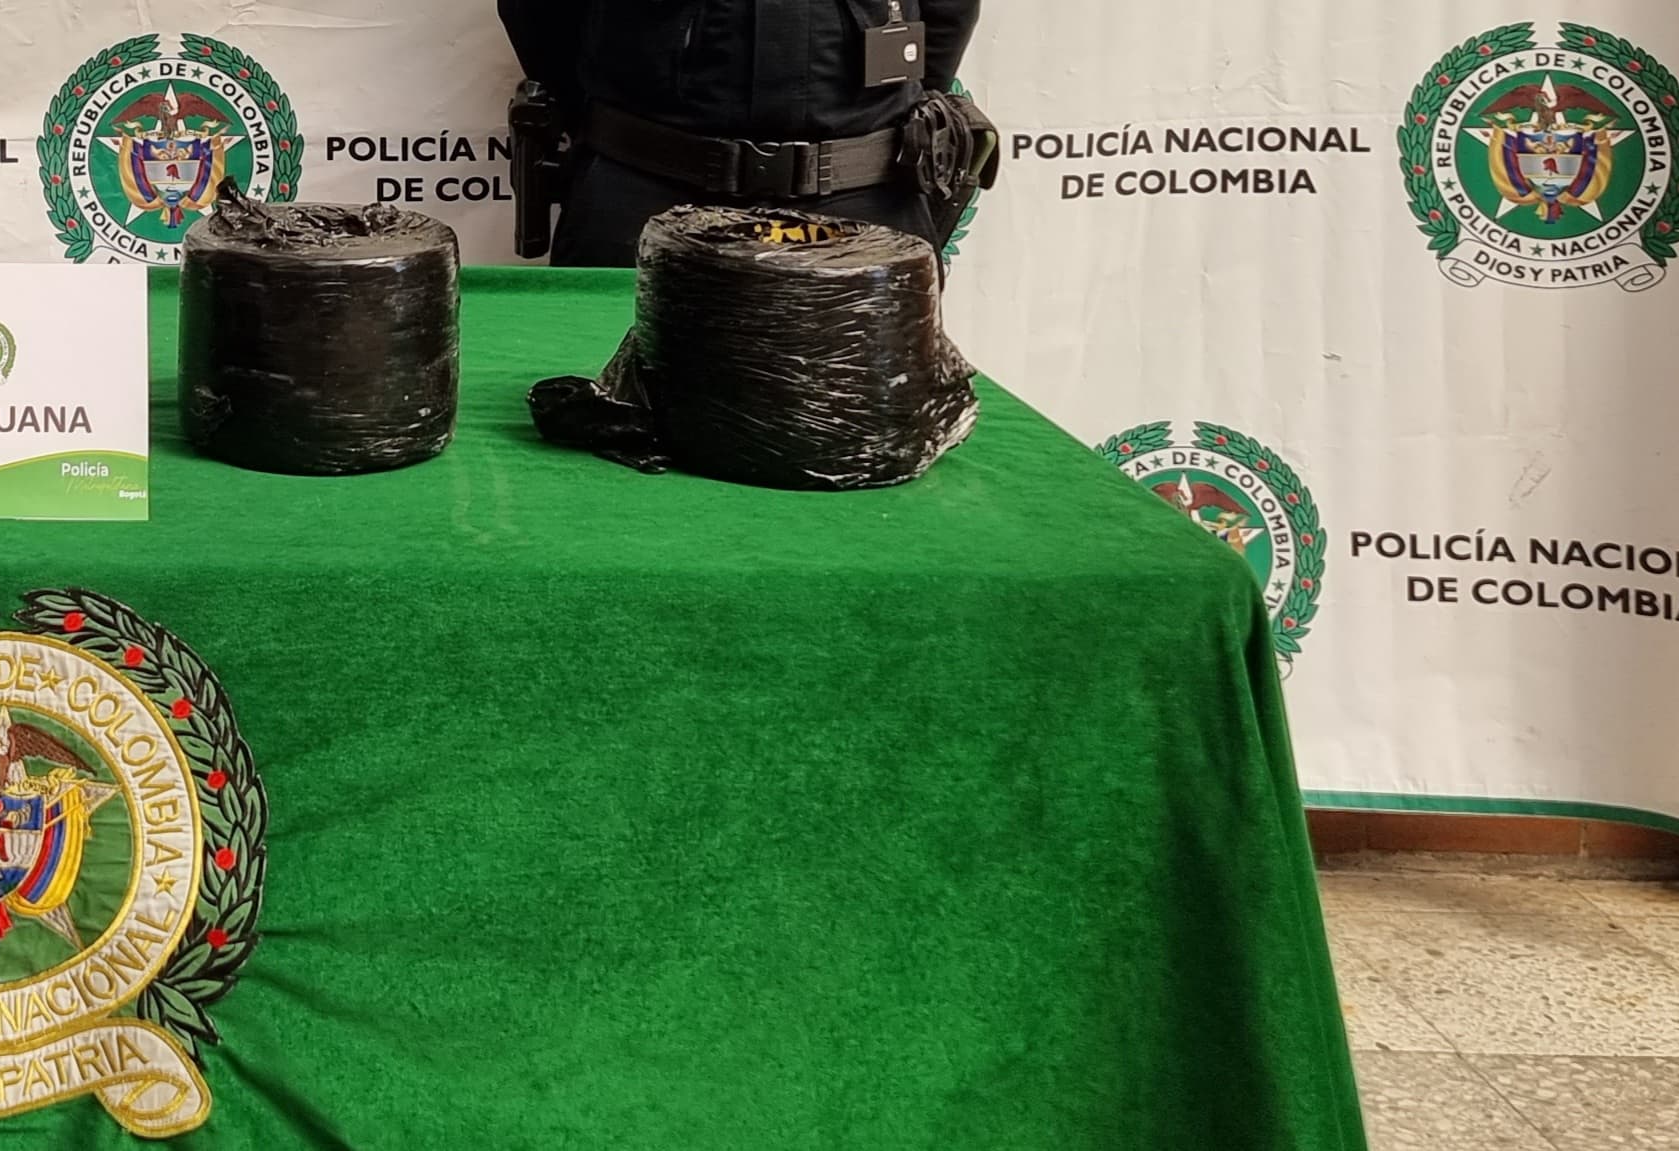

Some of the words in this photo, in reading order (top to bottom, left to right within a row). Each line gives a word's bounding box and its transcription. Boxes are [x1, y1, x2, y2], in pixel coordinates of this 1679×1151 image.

[1536, 53, 1565, 66] DE
[1593, 67, 1665, 172] COLOMBIA
[326, 131, 477, 162] POLICÍA
[1012, 123, 1154, 160] POLICÍA
[1164, 126, 1371, 153] NACIONAL
[376, 177, 424, 203] DE
[1061, 172, 1105, 200] DE
[1115, 168, 1317, 196] COLOMBIA
[1552, 197, 1655, 256] NACIONAL
[1474, 251, 1525, 278] DIOS
[1552, 255, 1629, 282] PATRIA
[62, 461, 108, 477] Policía
[1351, 528, 1517, 563] POLICÍA
[1530, 539, 1679, 576] NACIO
[1407, 576, 1458, 603] DE
[1472, 579, 1679, 621] COLOMBI
[68, 676, 183, 866] COLOMBIA
